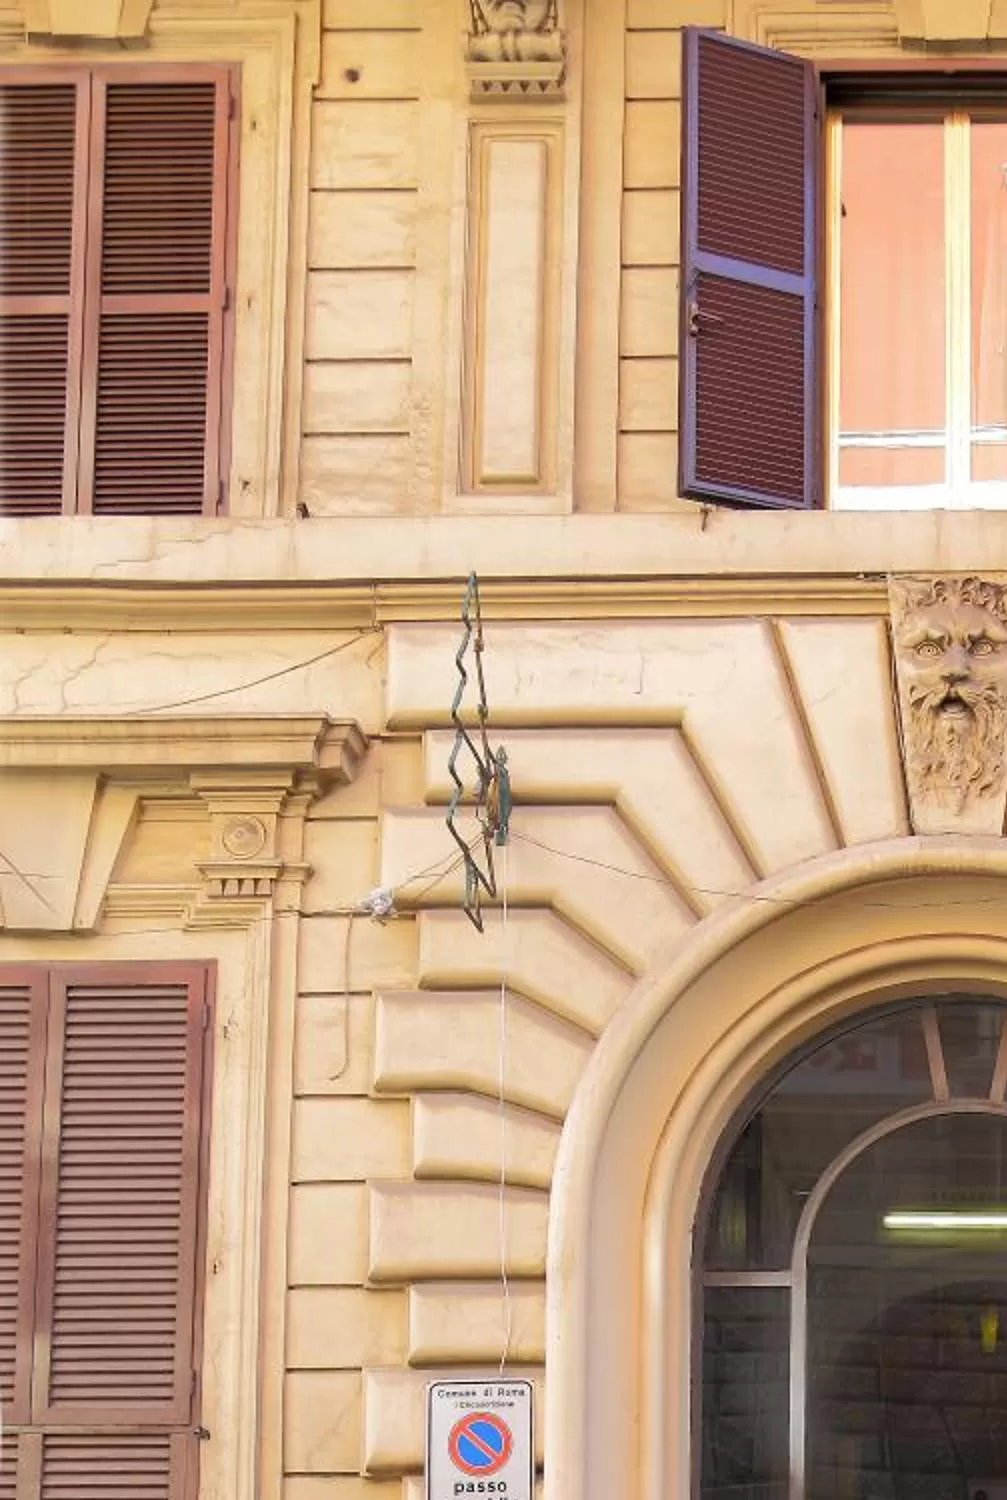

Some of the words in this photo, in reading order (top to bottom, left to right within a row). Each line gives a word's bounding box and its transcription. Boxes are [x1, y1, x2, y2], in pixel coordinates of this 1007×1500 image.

[437, 1389, 477, 1398] Comune
[484, 1388, 493, 1397] di
[498, 1387, 525, 1397] Roma
[453, 1481, 508, 1496] passo
